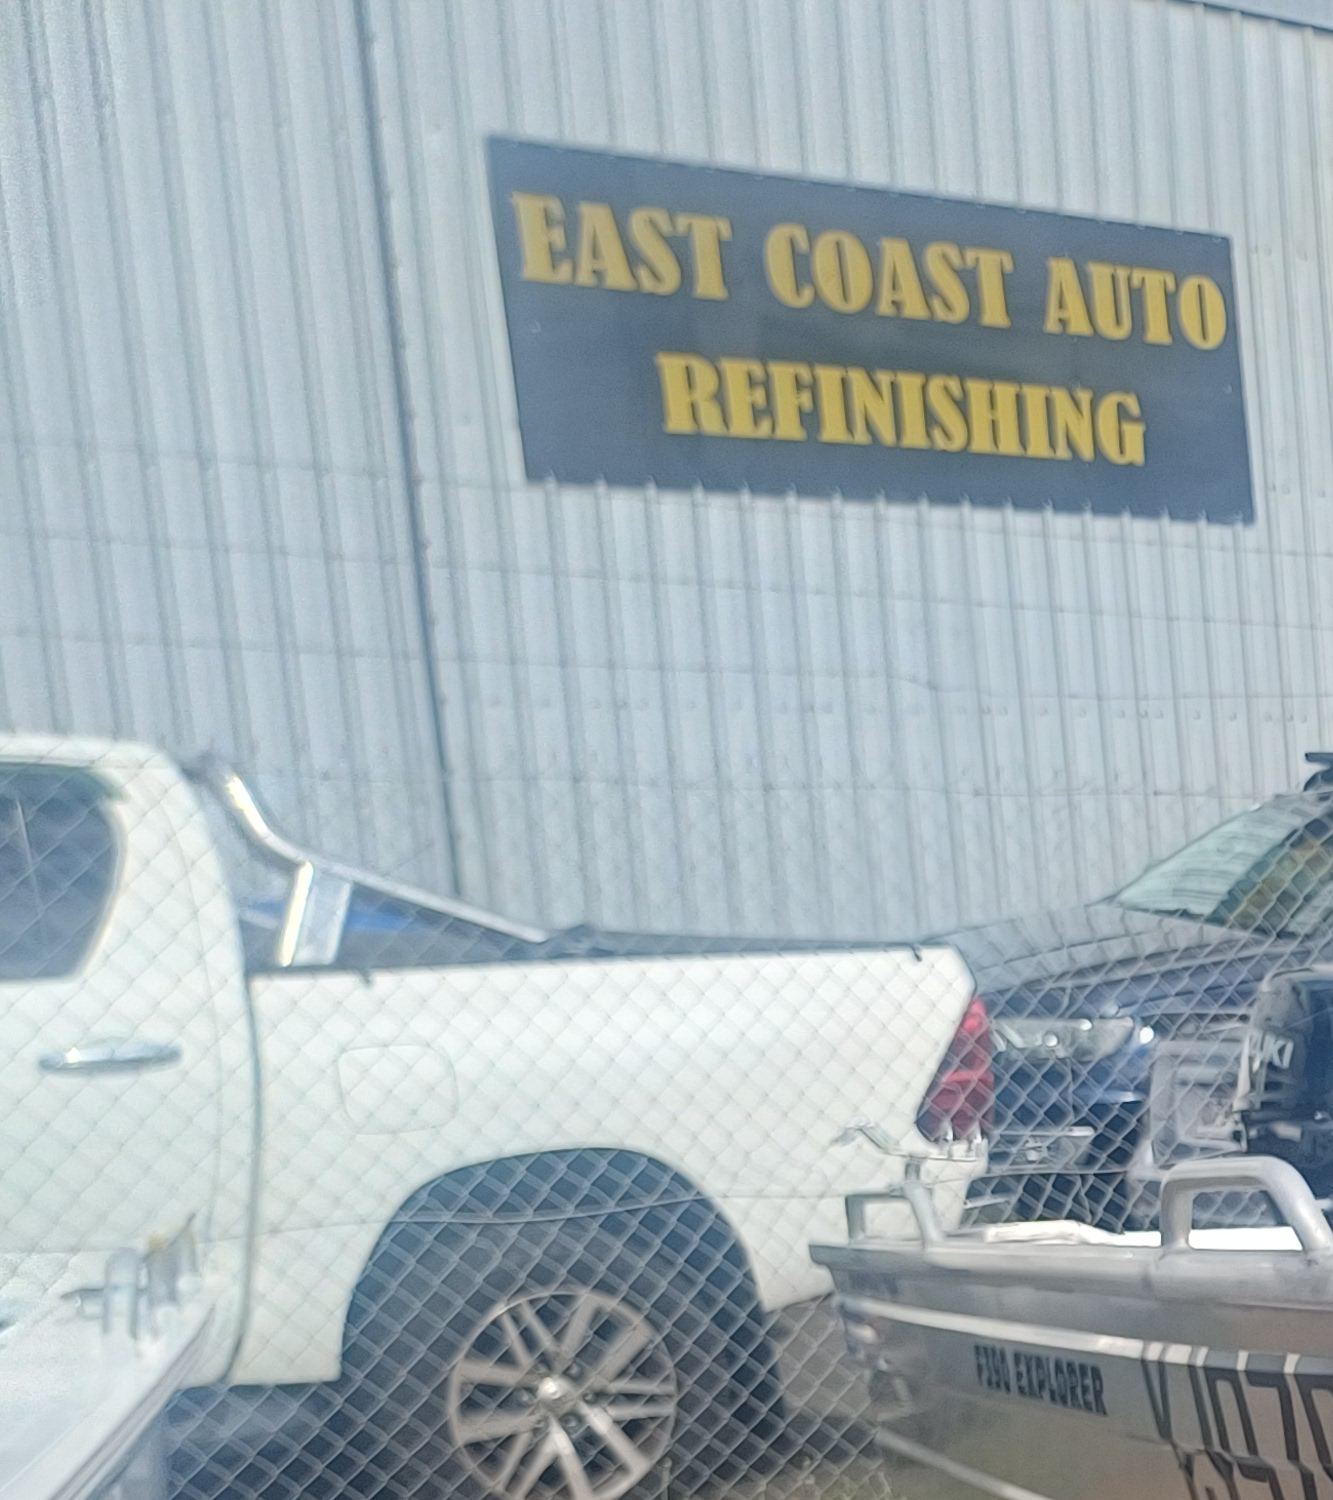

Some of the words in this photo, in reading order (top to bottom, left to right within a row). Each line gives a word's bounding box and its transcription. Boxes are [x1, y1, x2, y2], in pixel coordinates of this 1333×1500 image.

[512, 191, 732, 301] EAST
[765, 223, 1014, 329] COAST
[1045, 257, 1227, 351] AUTO
[656, 351, 1146, 467] REFINISHING
[1013, 1351, 1108, 1416] EXPLORER
